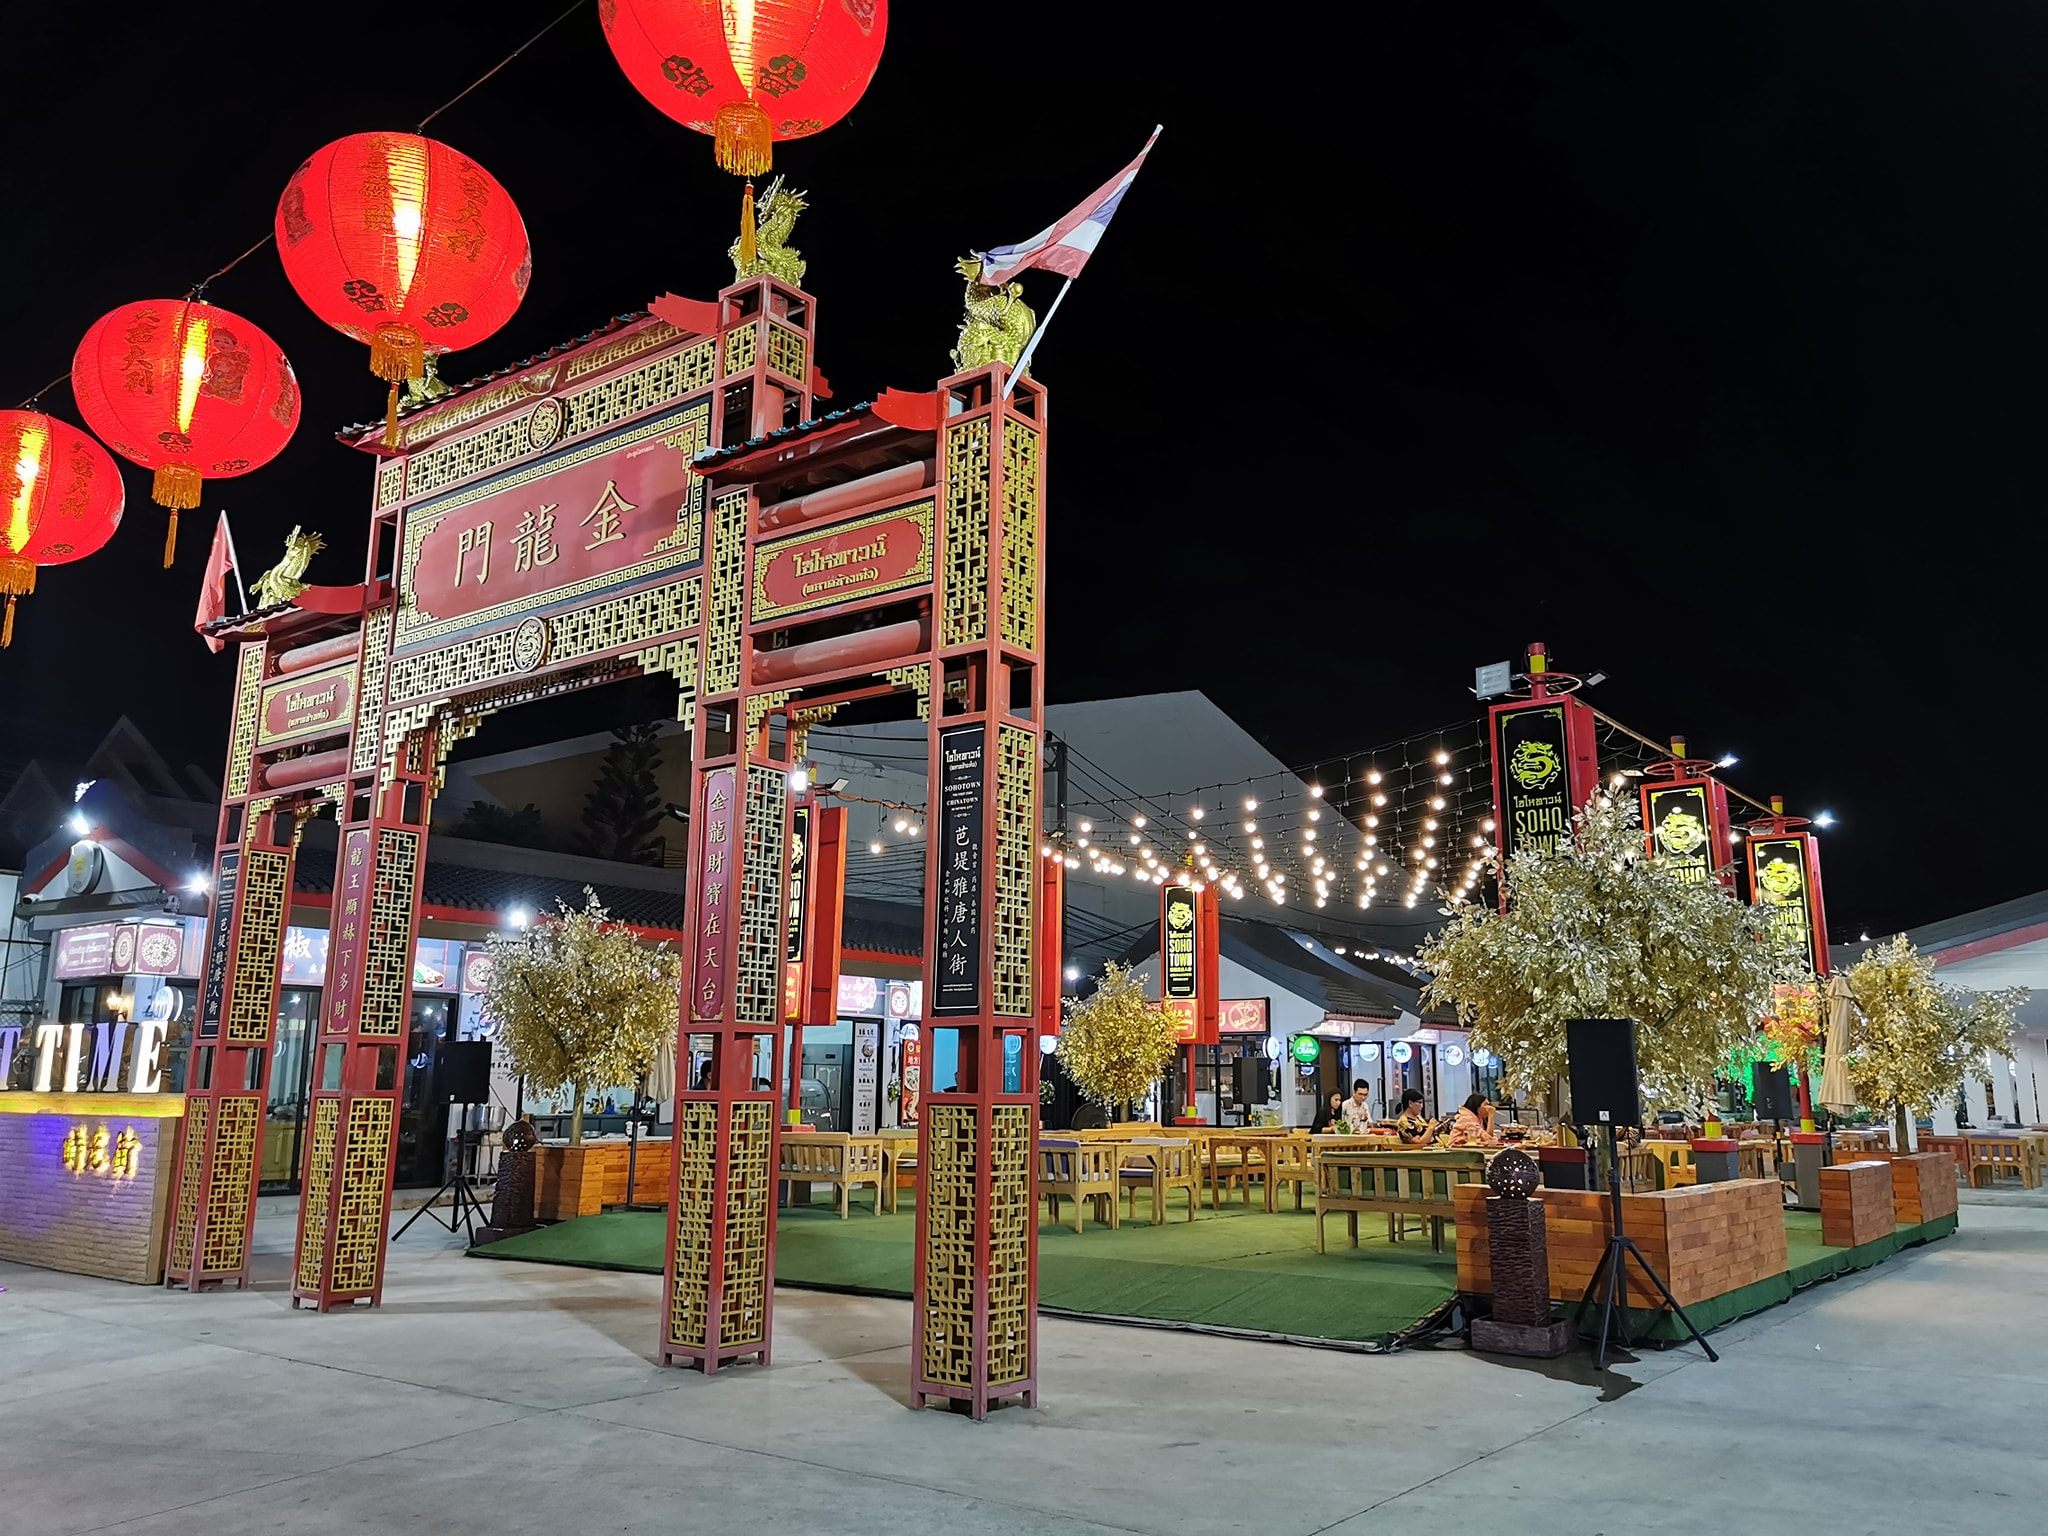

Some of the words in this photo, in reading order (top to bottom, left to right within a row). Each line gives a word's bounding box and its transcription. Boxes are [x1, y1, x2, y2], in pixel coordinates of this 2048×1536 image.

[944, 781, 981, 792] SOHOTOWN
[1515, 806, 1563, 834] SOHO
[701, 789, 728, 1002] 金龍財寶在天台
[948, 824, 971, 976] 芭堤雅唐人街
[1169, 938, 1192, 953] SOHO
[1169, 953, 1193, 967] TOWN
[32, 1020, 169, 1094] TIME
